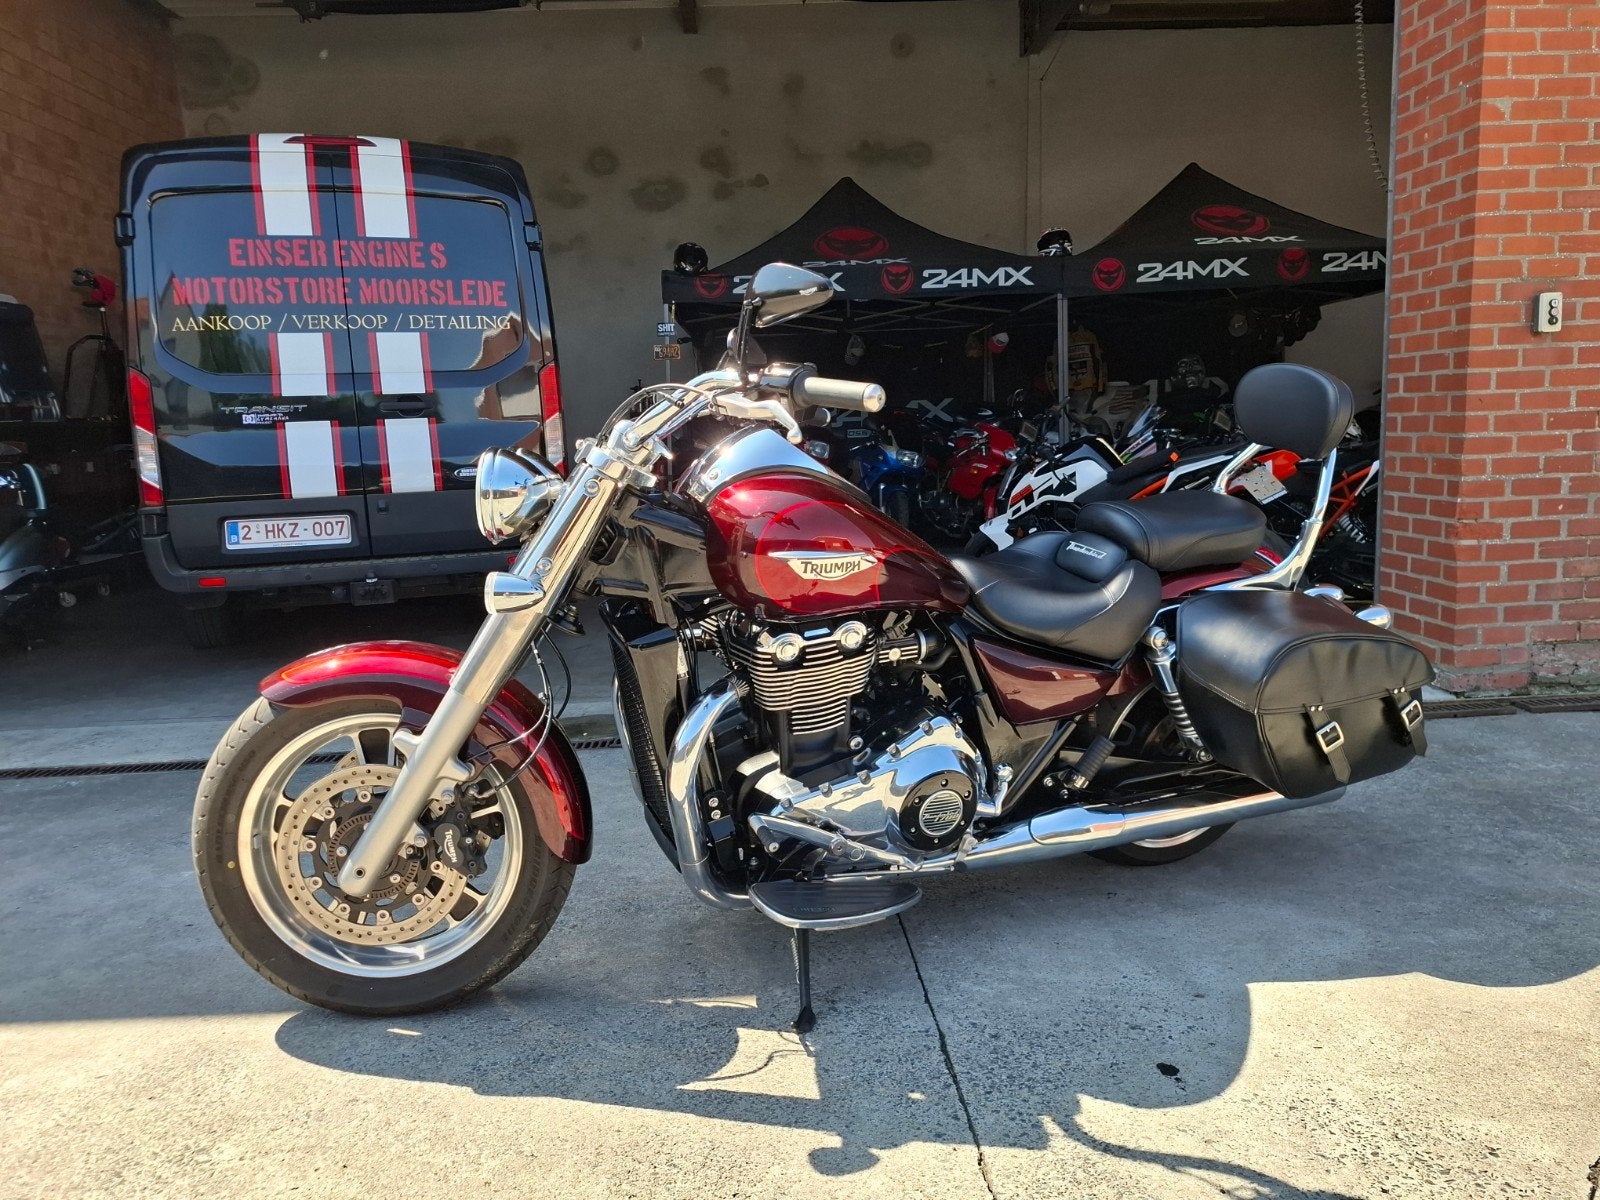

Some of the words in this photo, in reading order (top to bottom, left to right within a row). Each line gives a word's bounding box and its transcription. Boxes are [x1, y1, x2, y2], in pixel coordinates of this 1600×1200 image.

[1194, 235, 1305, 245] 24MX
[228, 238, 328, 267] EINSER
[802, 257, 911, 267] 24MX
[921, 265, 1035, 289] 24MX
[1136, 256, 1250, 283] 24MX
[172, 276, 353, 306] MOTORSTORE
[358, 278, 507, 307] MOORSLEDE
[171, 314, 272, 333] AANKOOP
[291, 313, 388, 331] VERKOOP
[408, 313, 511, 331] DETAILING
[657, 323, 675, 332] SHIT
[220, 404, 308, 415] TRANSIT
[230, 534, 238, 543] B
[801, 560, 861, 579] TRIUMPH
[444, 829, 458, 863] TRIUMPH
